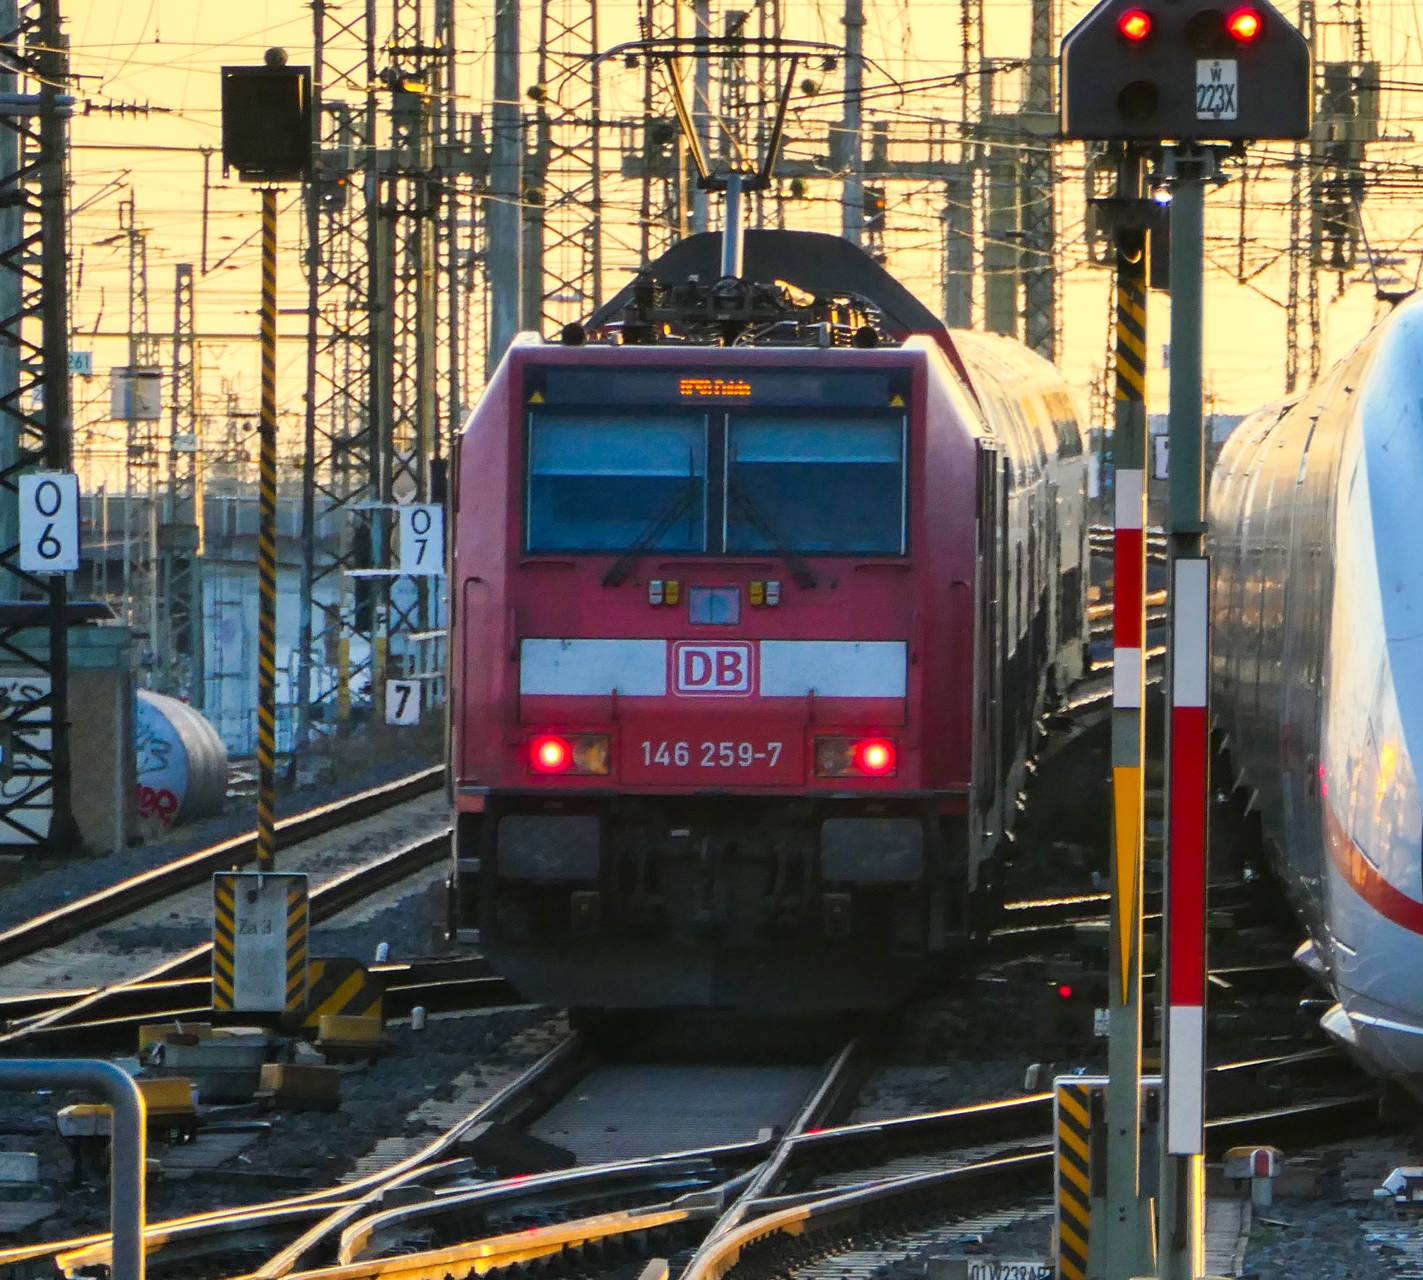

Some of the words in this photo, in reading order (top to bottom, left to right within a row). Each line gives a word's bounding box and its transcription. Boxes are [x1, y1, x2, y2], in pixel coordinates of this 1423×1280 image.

[1209, 68, 1222, 82] W
[1197, 84, 1235, 112] 223X
[684, 651, 743, 687] DB
[395, 684, 411, 719] 7
[641, 741, 689, 767] 146
[700, 741, 783, 767] 259-7
